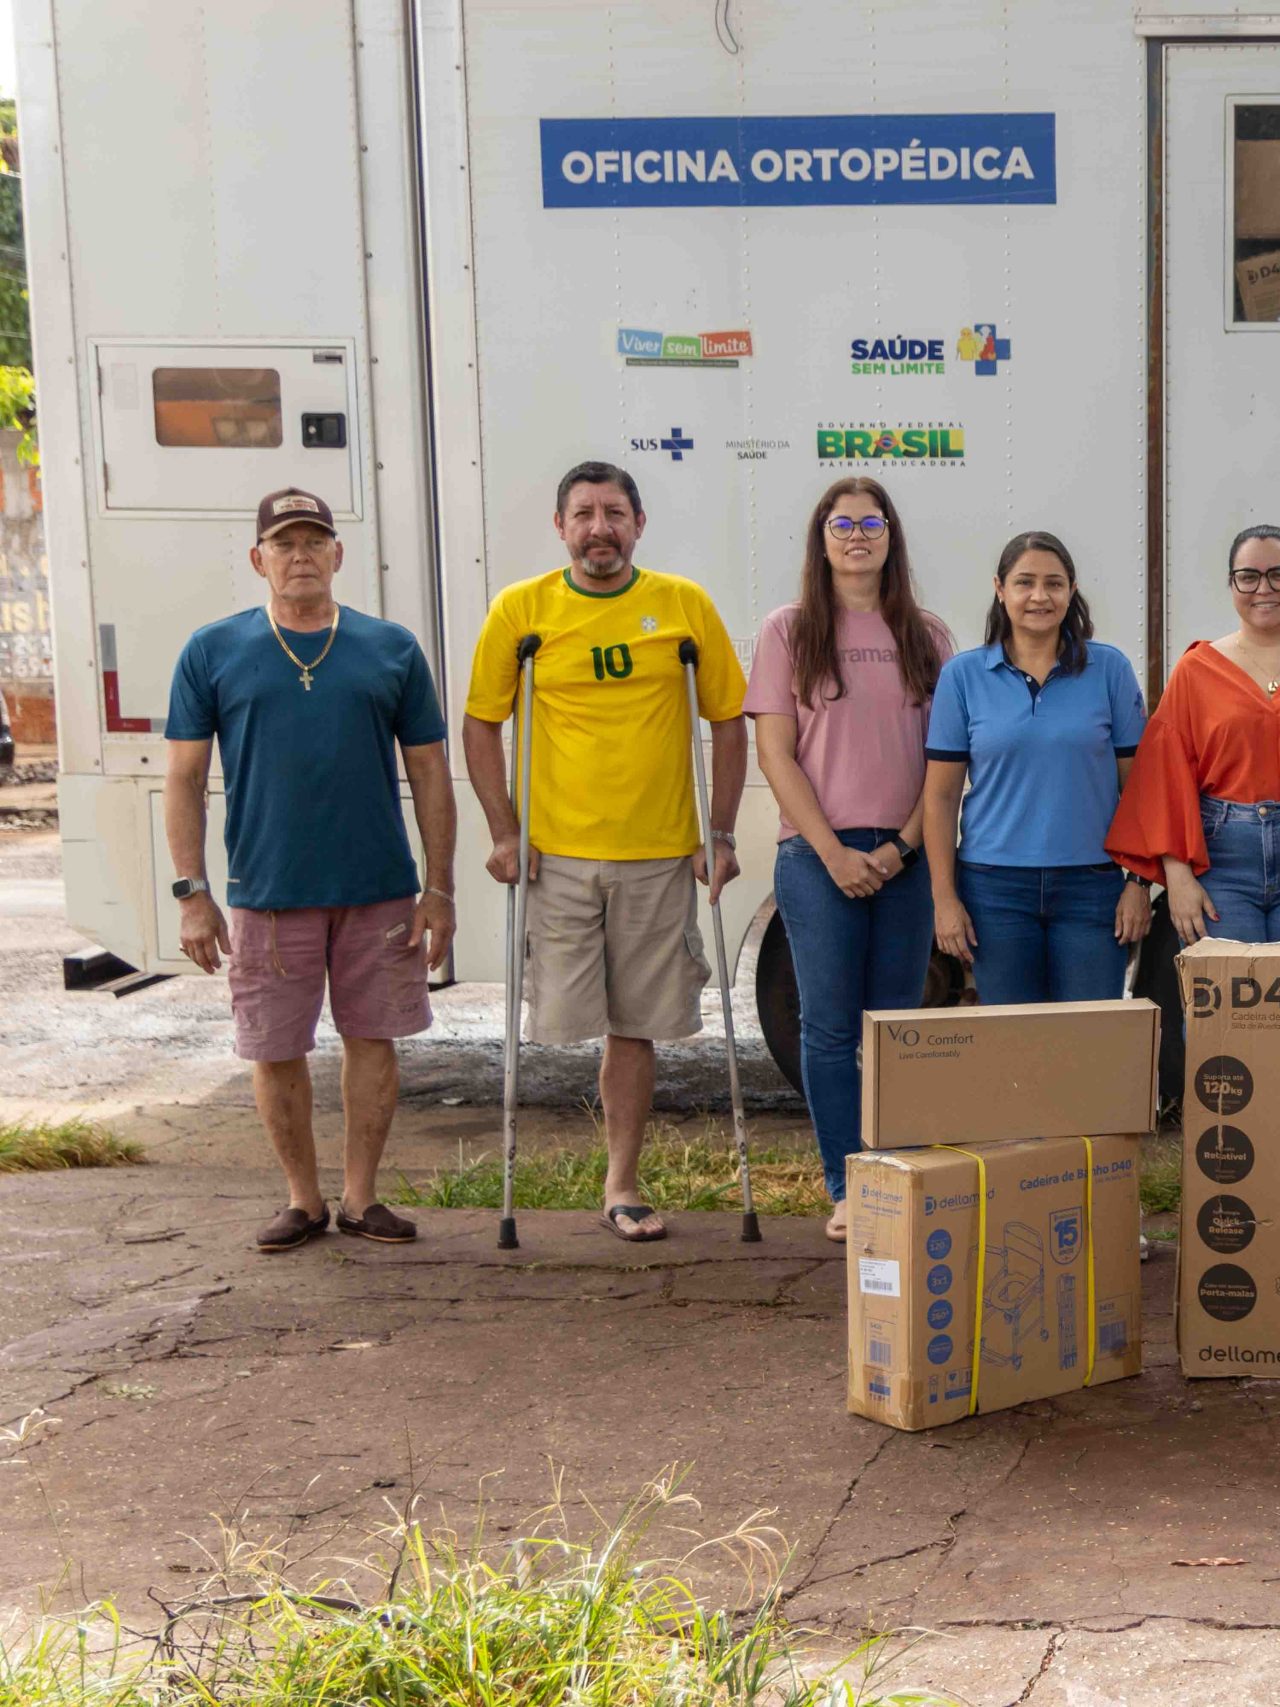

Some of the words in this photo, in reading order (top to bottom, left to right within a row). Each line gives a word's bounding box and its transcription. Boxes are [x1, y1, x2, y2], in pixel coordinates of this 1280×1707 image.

[562, 150, 740, 184] OFICINA
[751, 139, 1035, 183] ORTOPÉDICA
[621, 332, 661, 353] Viver
[666, 342, 697, 356] sem
[704, 336, 749, 355] limite
[851, 334, 945, 361] SAÚDE
[851, 362, 886, 375] SEM
[890, 362, 945, 375] LIMITE
[817, 421, 887, 429] GOVERNO
[898, 421, 965, 429] FEDERAL
[631, 438, 658, 451] SUS
[777, 440, 790, 449] DA
[817, 429, 965, 459] BRASIL
[819, 459, 869, 468] PÁTRIA
[882, 460, 966, 468] EDUCADORA
[590, 643, 633, 680] 10
[1231, 1012, 1268, 1022] Cadeira
[1270, 1012, 1280, 1022] de
[927, 1033, 974, 1046] Comfort
[1020, 1174, 1059, 1191] Cadeira
[1062, 1170, 1074, 1183] de
[1111, 1159, 1132, 1173] D40
[938, 1187, 996, 1209] dellamd
[1054, 1217, 1079, 1248] 15
